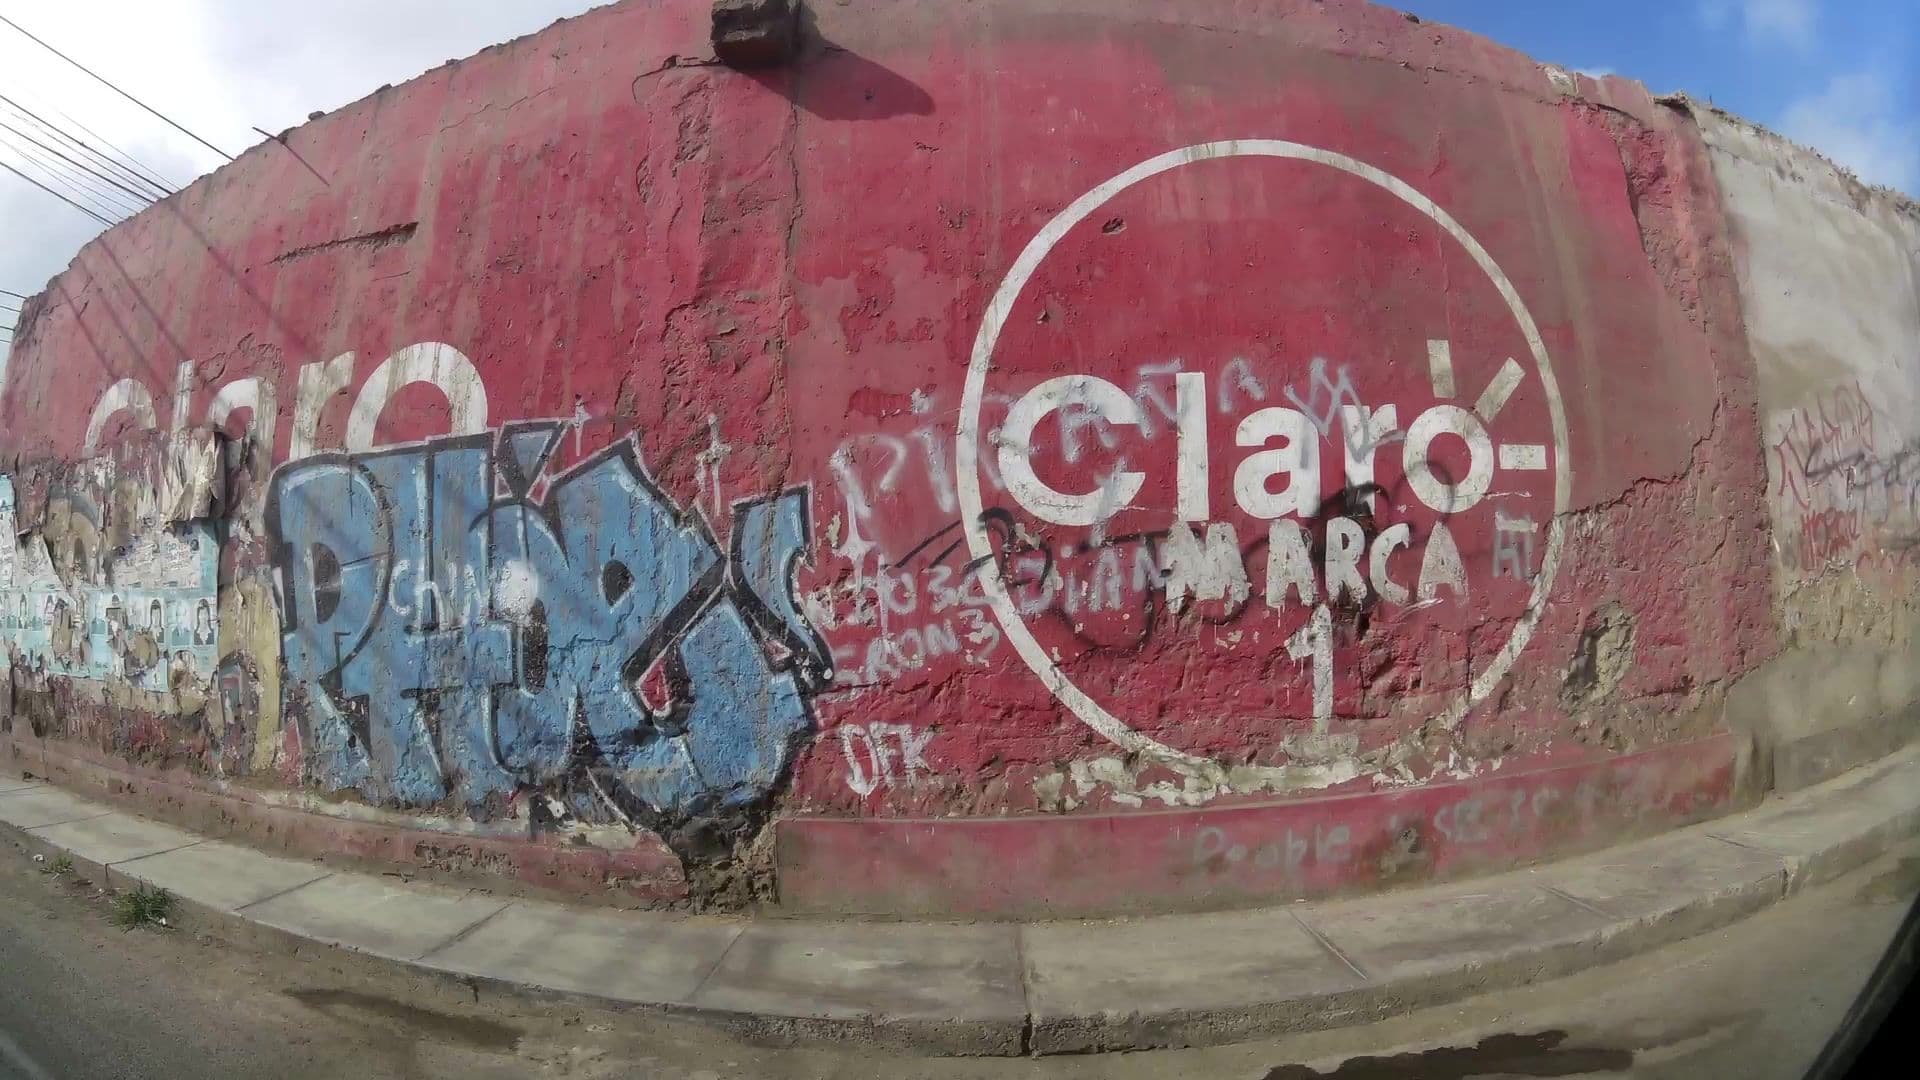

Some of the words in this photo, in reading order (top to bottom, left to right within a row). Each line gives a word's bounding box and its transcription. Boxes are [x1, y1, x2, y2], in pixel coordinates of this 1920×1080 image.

[997, 370, 1495, 526] Claro
[1164, 515, 1470, 616] MARCA
[1283, 603, 1358, 758] 1
